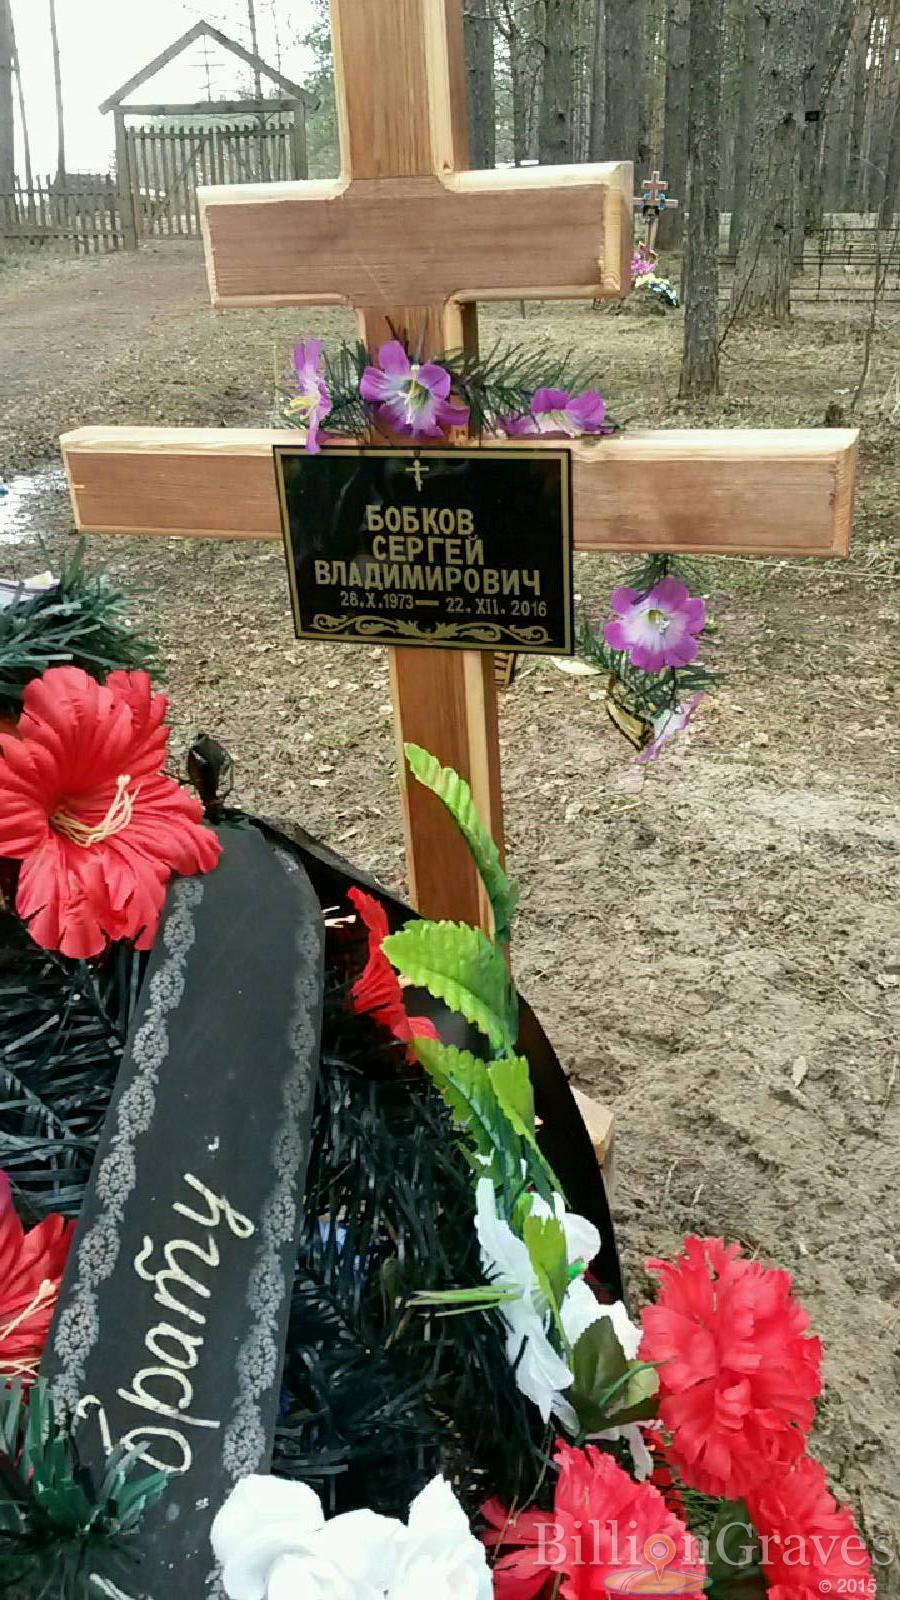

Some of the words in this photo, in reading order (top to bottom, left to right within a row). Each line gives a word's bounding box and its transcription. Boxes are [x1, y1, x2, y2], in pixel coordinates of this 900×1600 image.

[365, 504, 475, 535] БОБКОВ
[372, 534, 484, 566] СЕРГЕЙ
[314, 560, 541, 596] ВЛАДИМИРОВИЧ
[511, 600, 547, 617] 2016
